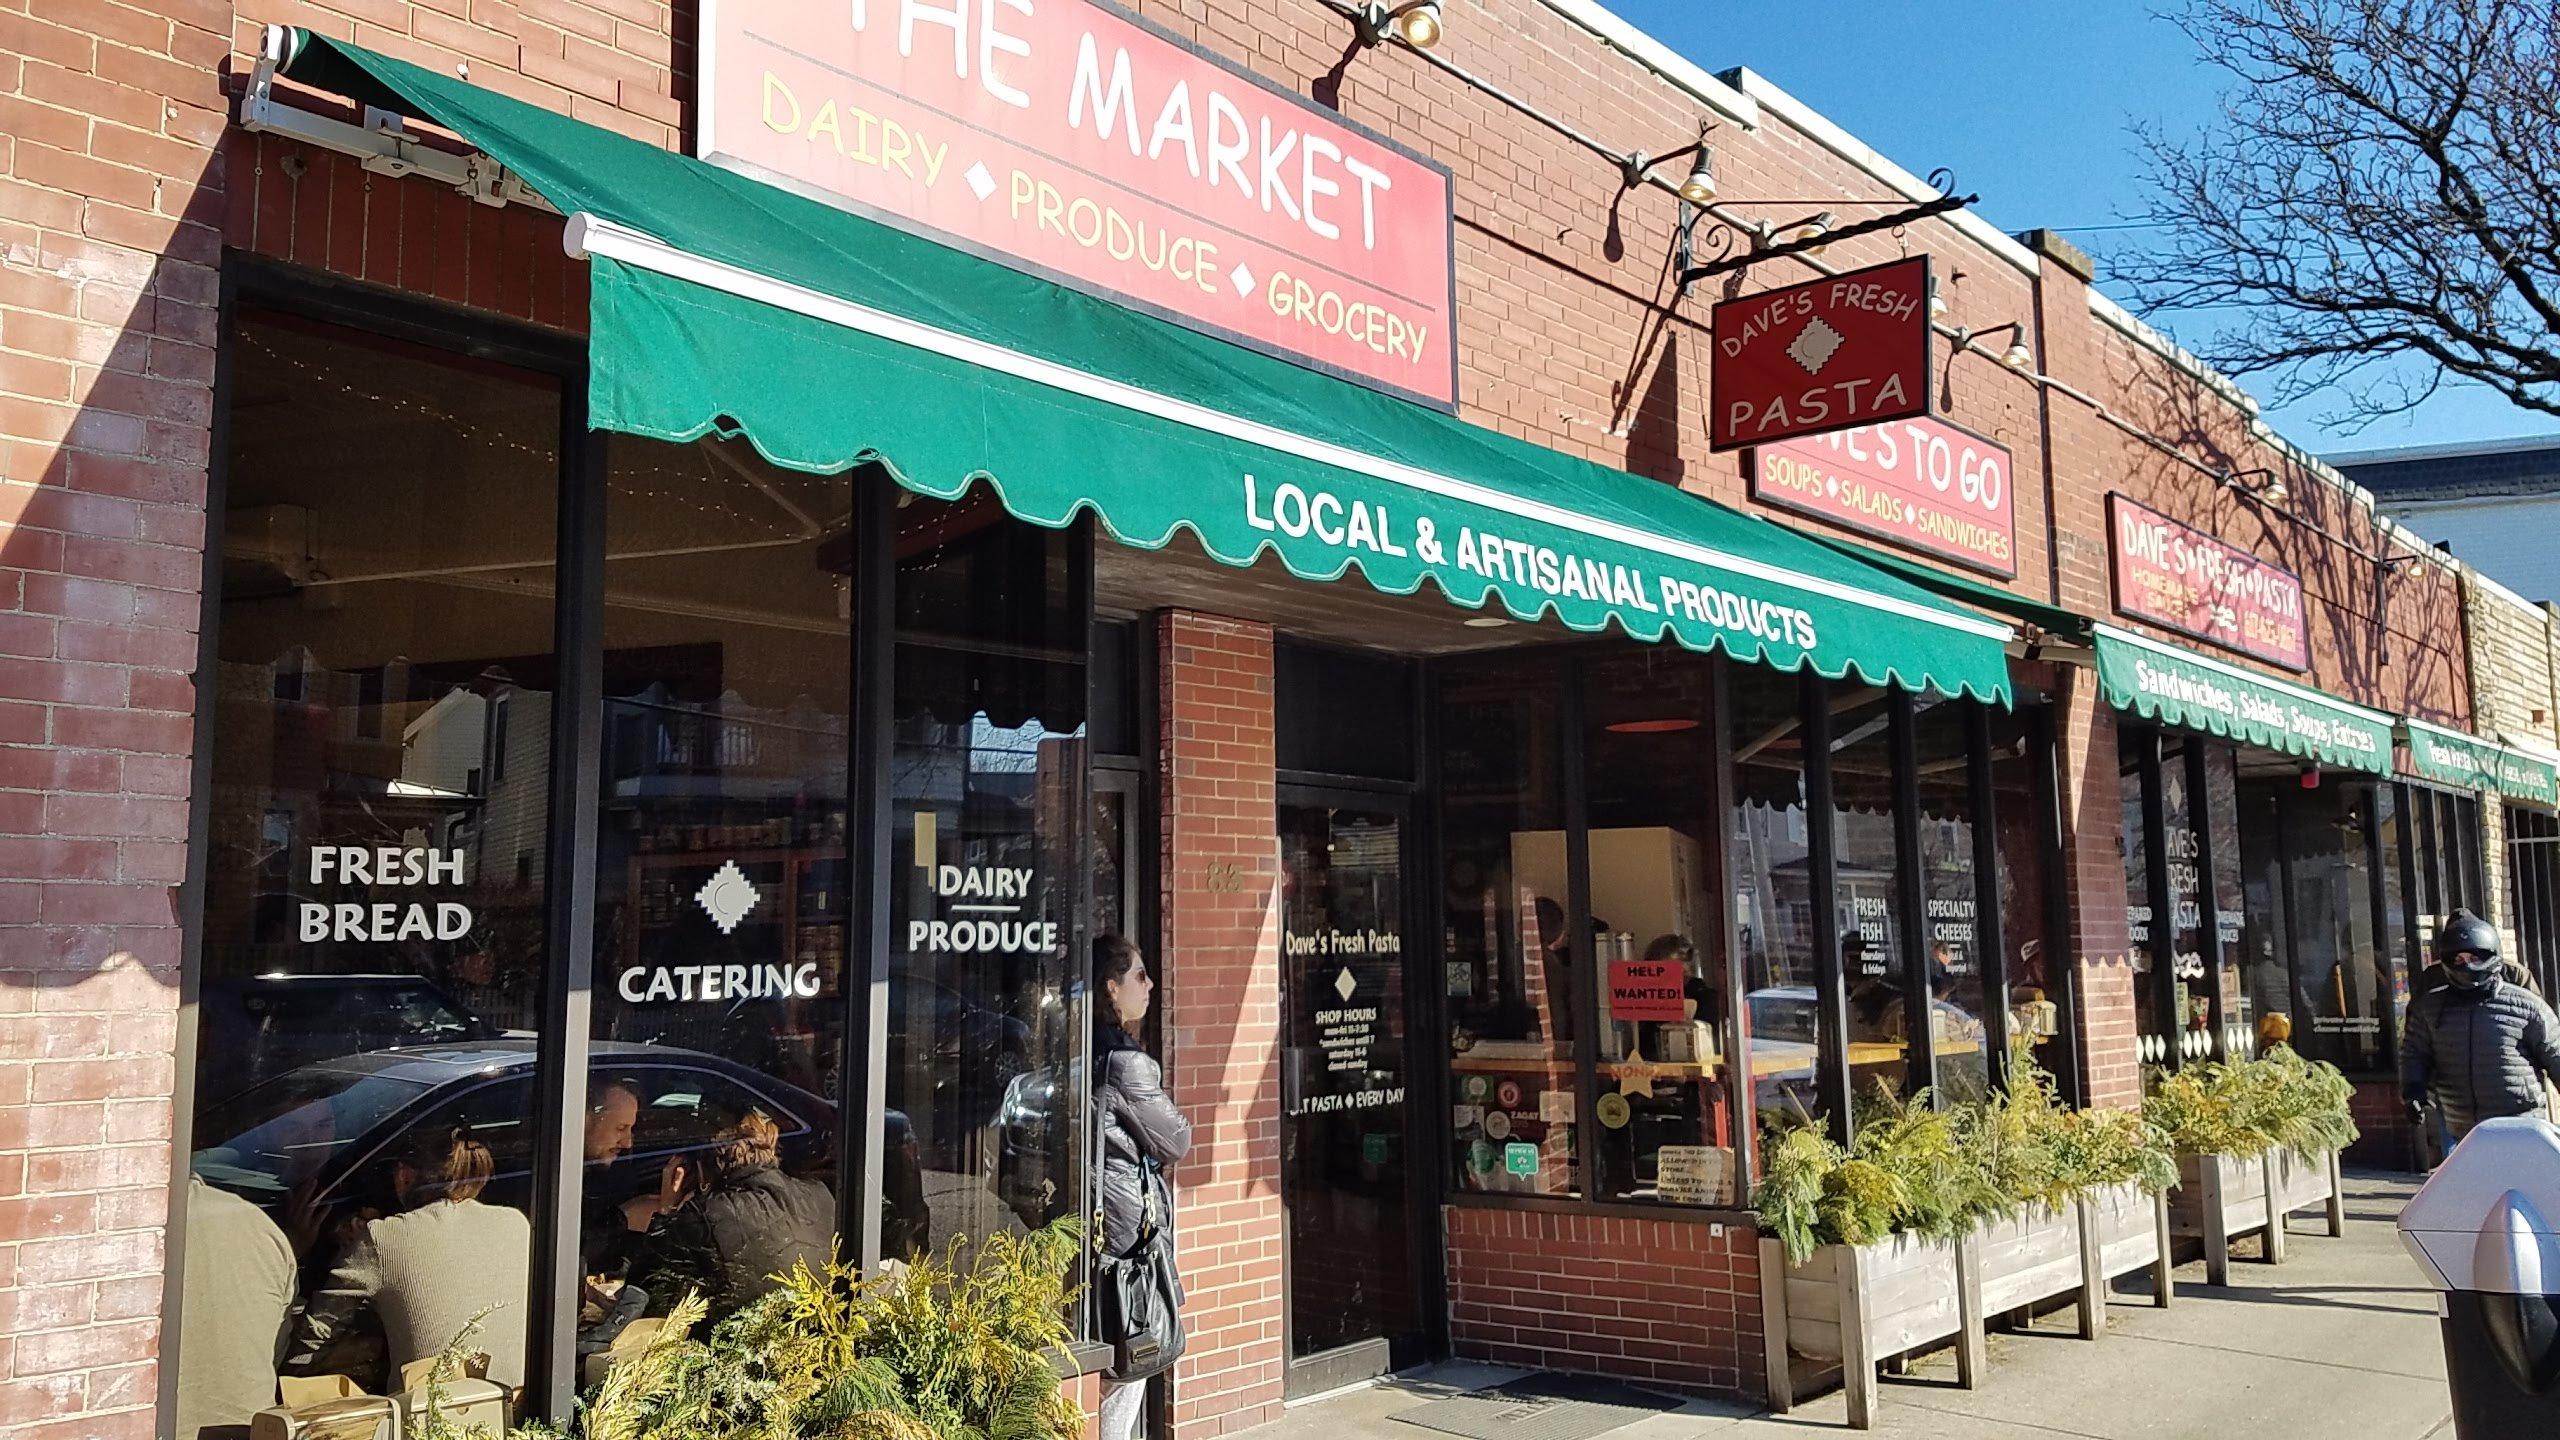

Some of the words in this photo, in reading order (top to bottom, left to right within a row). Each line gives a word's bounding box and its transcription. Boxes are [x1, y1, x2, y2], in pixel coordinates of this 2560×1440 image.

[1067, 31, 1392, 251] MARKET
[762, 69, 949, 189] DAIRY
[1010, 168, 1219, 294] PRODUCE
[1267, 271, 1428, 364] GROCERY
[1721, 290, 1814, 358] DAVE'S
[1829, 283, 1918, 322] FRESH
[1729, 372, 1908, 438] PASTA
[1904, 424, 1951, 492] TO
[1959, 446, 2002, 511] GO
[1765, 453, 1823, 498] SOUPS
[1840, 480, 1903, 524] SALADS
[1917, 507, 2009, 560] SANDWICHES
[1244, 473, 1408, 558] LOCAL
[1415, 516, 1449, 566] &
[1456, 526, 1660, 614] ARTISANAL
[1659, 575, 1818, 650] PRODUCTS
[2122, 511, 2188, 575] DAVES
[2254, 568, 2299, 620] PASTA
[2134, 659, 2239, 722] Sandwiches,
[2239, 690, 2290, 735] Salads,
[2290, 705, 2332, 748] Soups,
[310, 845, 464, 886] FRESH
[939, 864, 1034, 898] DAIRY
[2168, 863, 2200, 894] RESH
[299, 902, 473, 943] BREAD
[1854, 897, 1887, 917] FRESH
[1927, 899, 1976, 918] SPECIALTY
[2172, 901, 2202, 928] ASTA
[909, 920, 1058, 953] PRODUCE
[1285, 929, 1328, 956] Dave's
[1331, 928, 1366, 955] Fresh
[1368, 928, 1401, 953] Pasta
[1860, 922, 1884, 941] FISH
[1934, 922, 1973, 941] CHEESES
[618, 962, 821, 1003] CATERING
[1627, 966, 1665, 977] HELP
[1613, 988, 1681, 1000] WANTED!
[1315, 1009, 1342, 1025] SHOP
[1343, 1007, 1377, 1022] HOURS
[1311, 1094, 1344, 1113] PASTA
[1355, 1089, 1384, 1109] EVERY
[1386, 1087, 1405, 1104] DAY
[1510, 1111, 1539, 1120] ZAGAT
